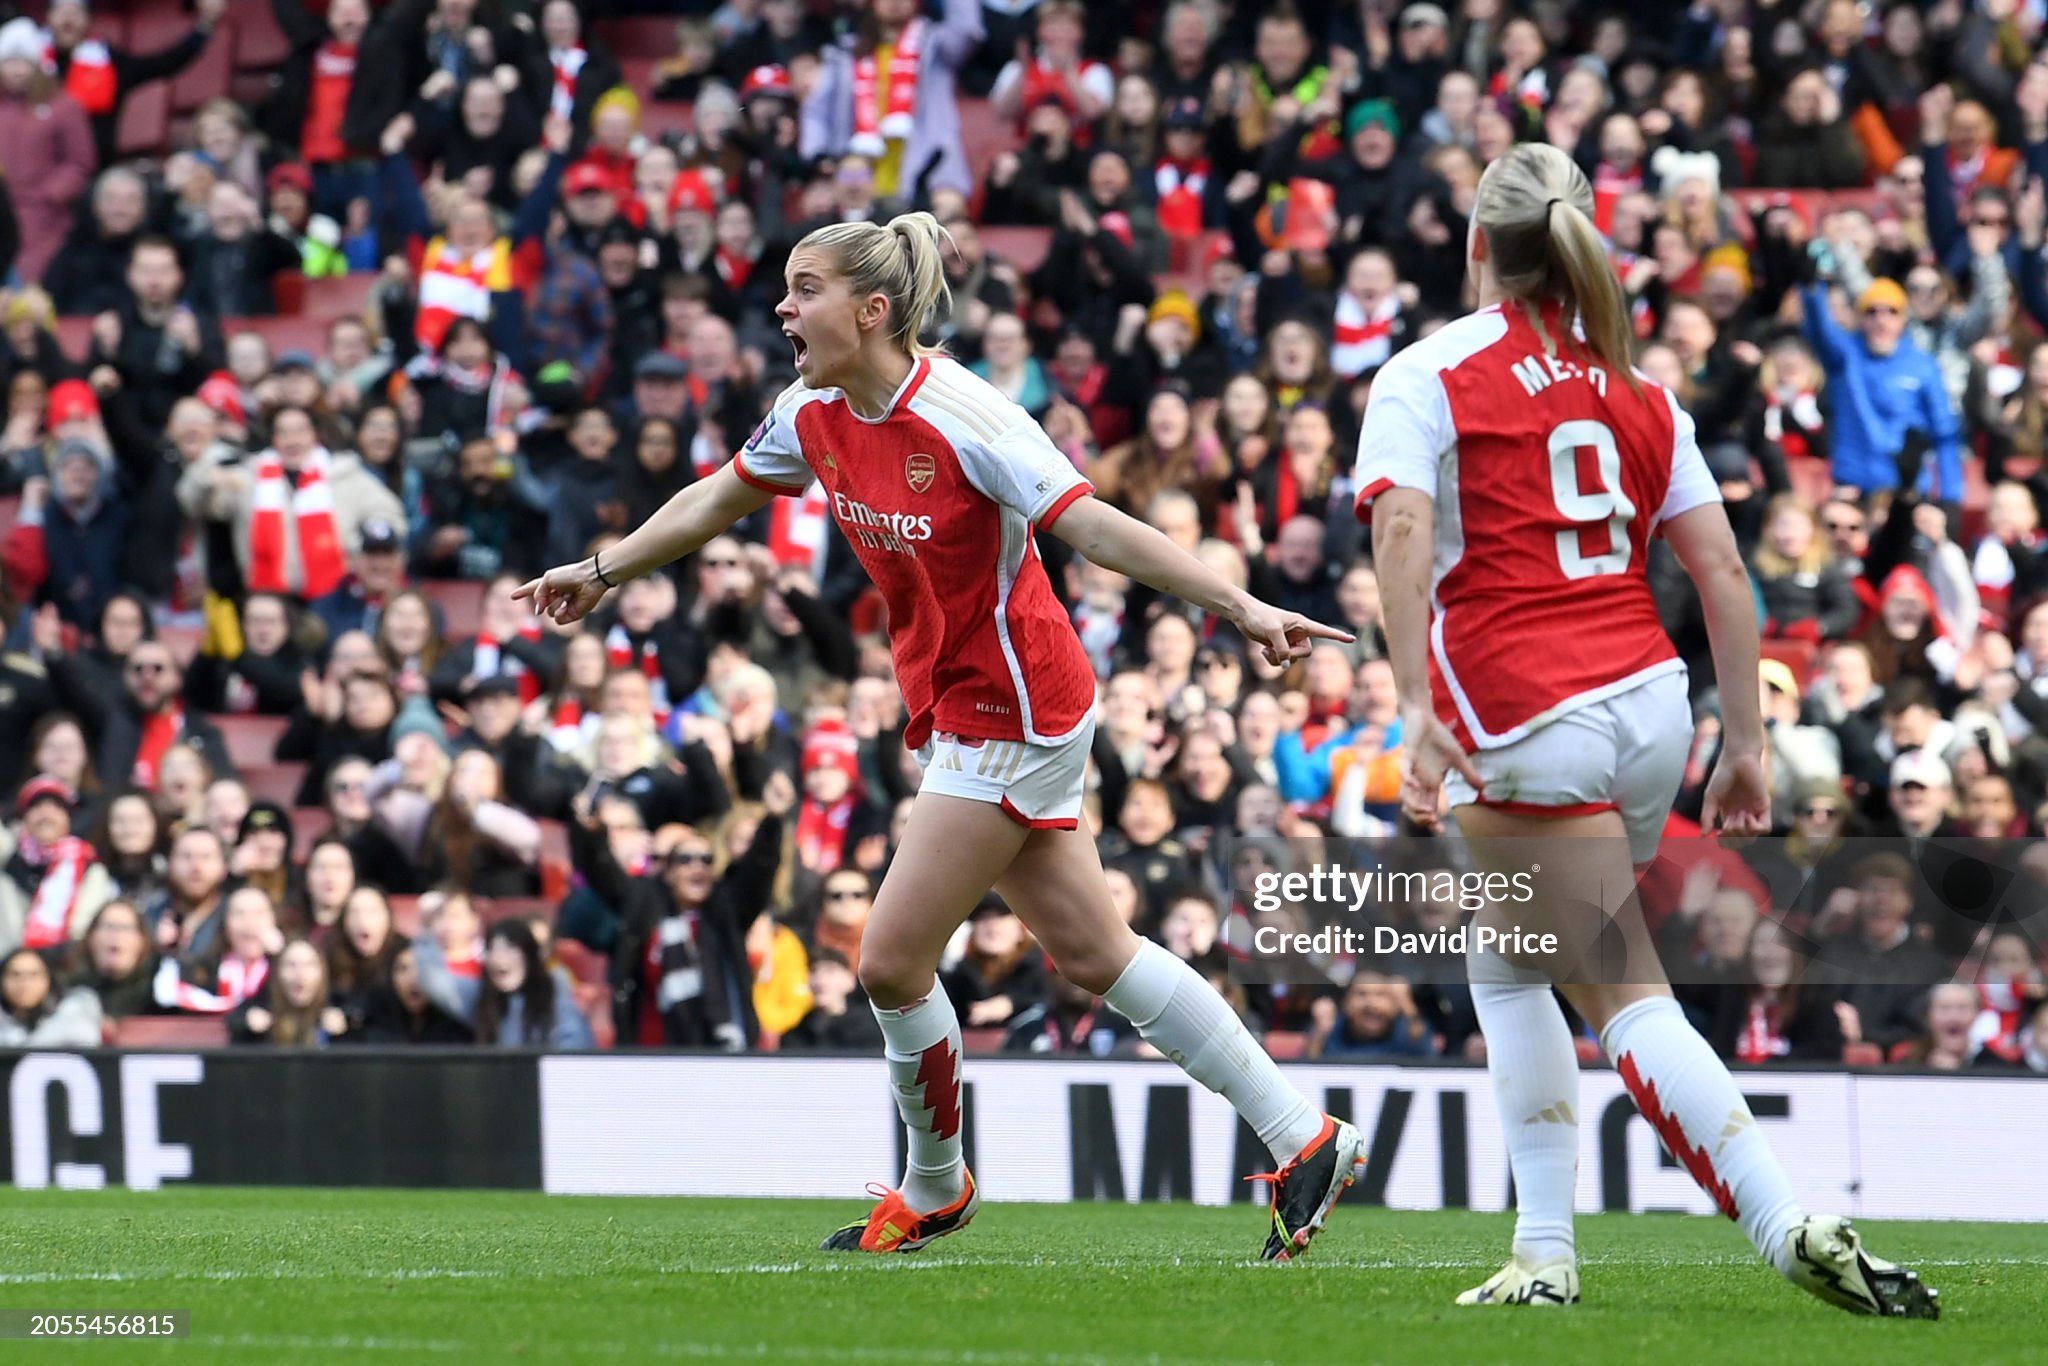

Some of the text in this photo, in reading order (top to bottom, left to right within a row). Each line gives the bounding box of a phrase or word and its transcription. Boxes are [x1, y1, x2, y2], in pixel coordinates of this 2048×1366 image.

[1510, 353, 1607, 398] ME
[833, 490, 932, 541] Emates
[1547, 418, 1637, 581] 9
